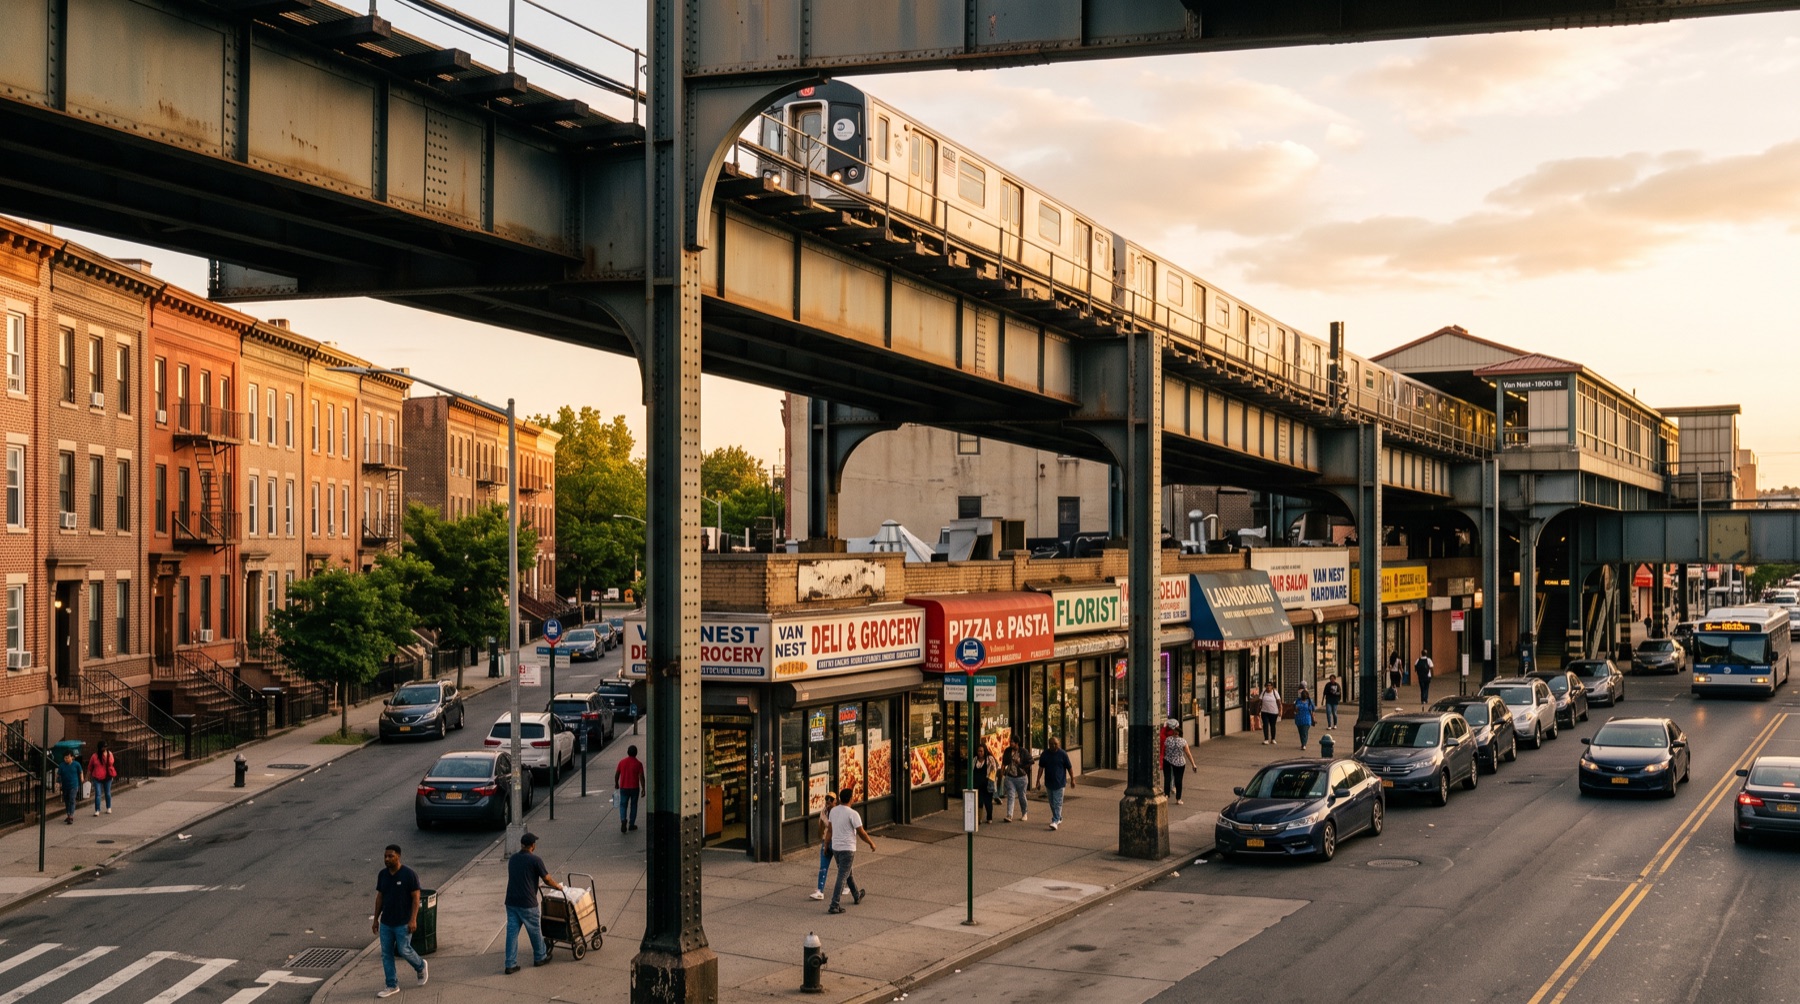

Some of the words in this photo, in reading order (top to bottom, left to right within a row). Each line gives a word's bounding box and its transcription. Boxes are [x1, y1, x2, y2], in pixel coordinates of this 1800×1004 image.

[1270, 574, 1285, 592] AIR
[1285, 573, 1308, 591] SALON
[1313, 568, 1327, 583] VAN
[1328, 567, 1345, 582] NEST
[1206, 584, 1274, 608] LAUNDROMAT
[1311, 585, 1347, 602] HARDWARE
[1057, 596, 1118, 627] FLORIST
[701, 626, 759, 643] NEST
[779, 625, 803, 640] VAN
[811, 624, 842, 655] DELI
[847, 622, 856, 651] &
[861, 617, 921, 650] GROCERY
[949, 618, 992, 645] PIZZA
[996, 620, 1004, 639] &
[1008, 613, 1050, 639] PASTA
[701, 646, 764, 662] ROCERY
[775, 641, 806, 658] NEST
